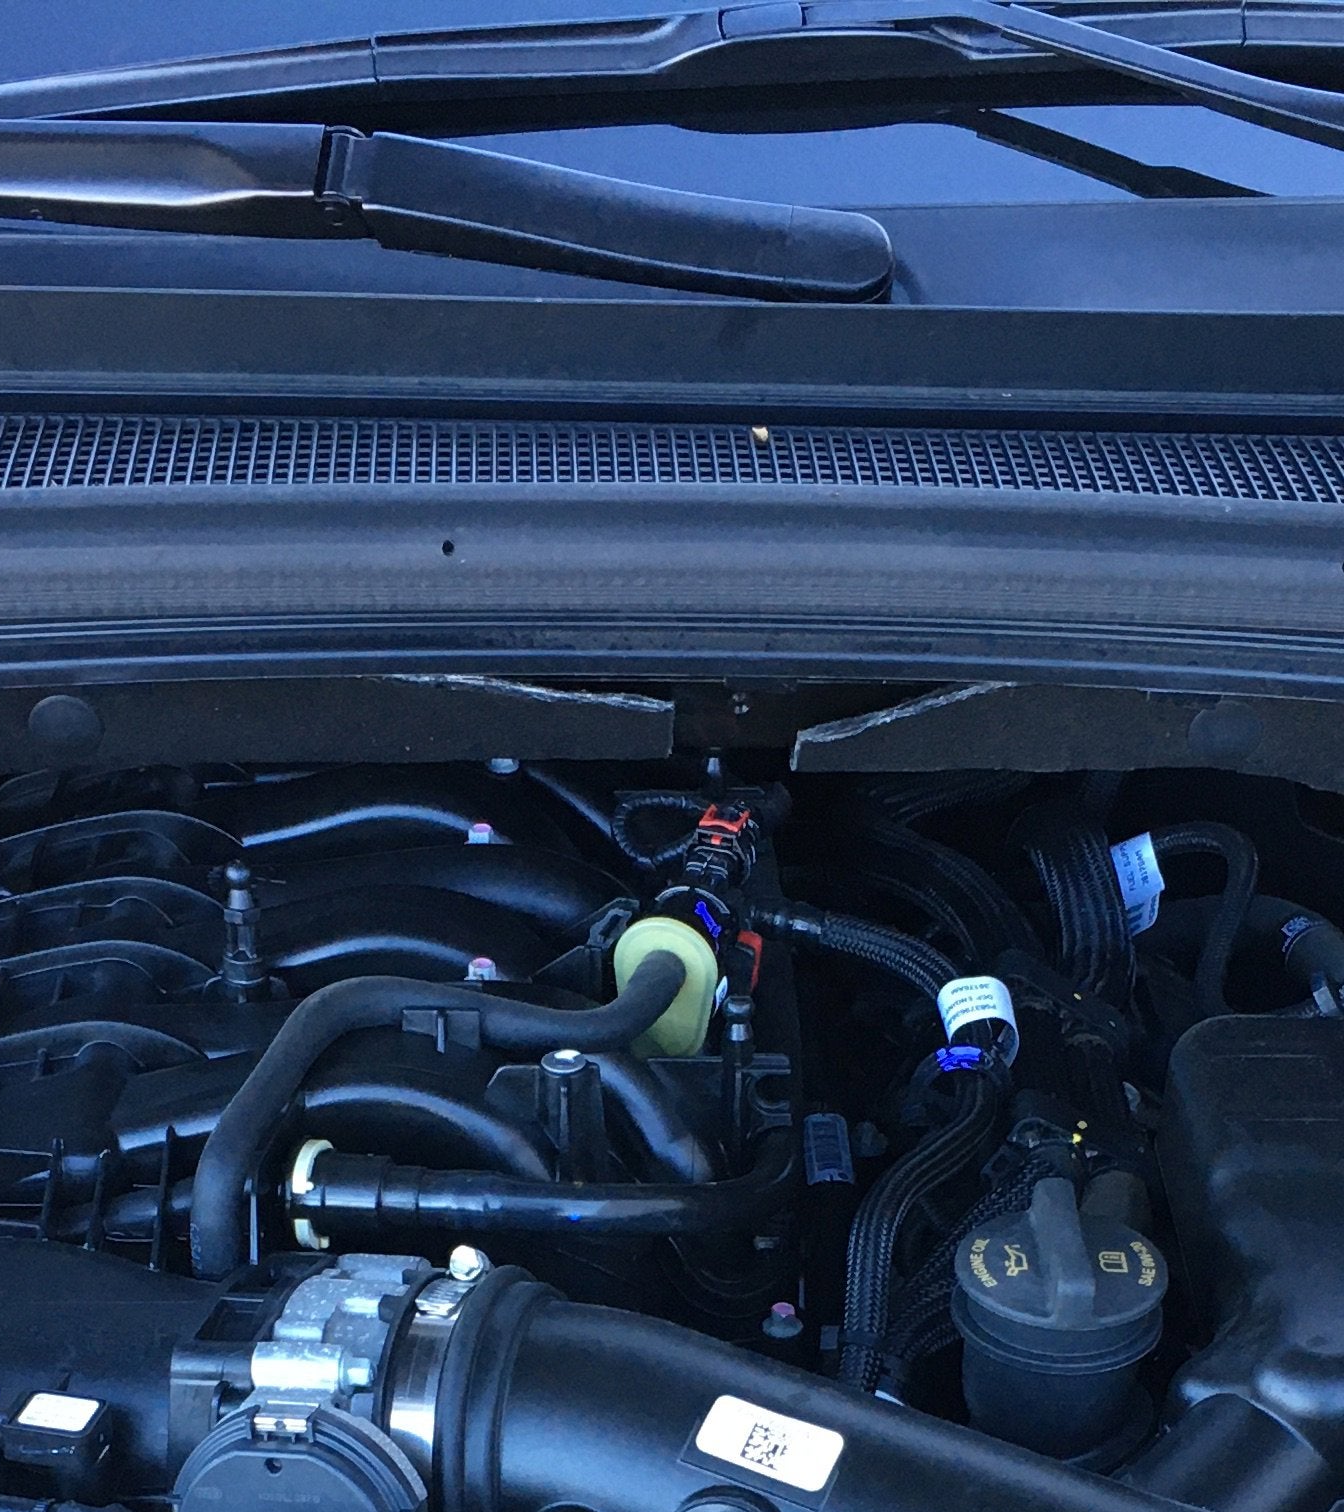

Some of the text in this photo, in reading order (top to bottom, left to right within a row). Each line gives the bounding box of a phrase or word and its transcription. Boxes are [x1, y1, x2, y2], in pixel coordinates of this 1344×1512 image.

[969, 1237, 998, 1288] ENGINE OIL
[1138, 1268, 1156, 1287] SAE
